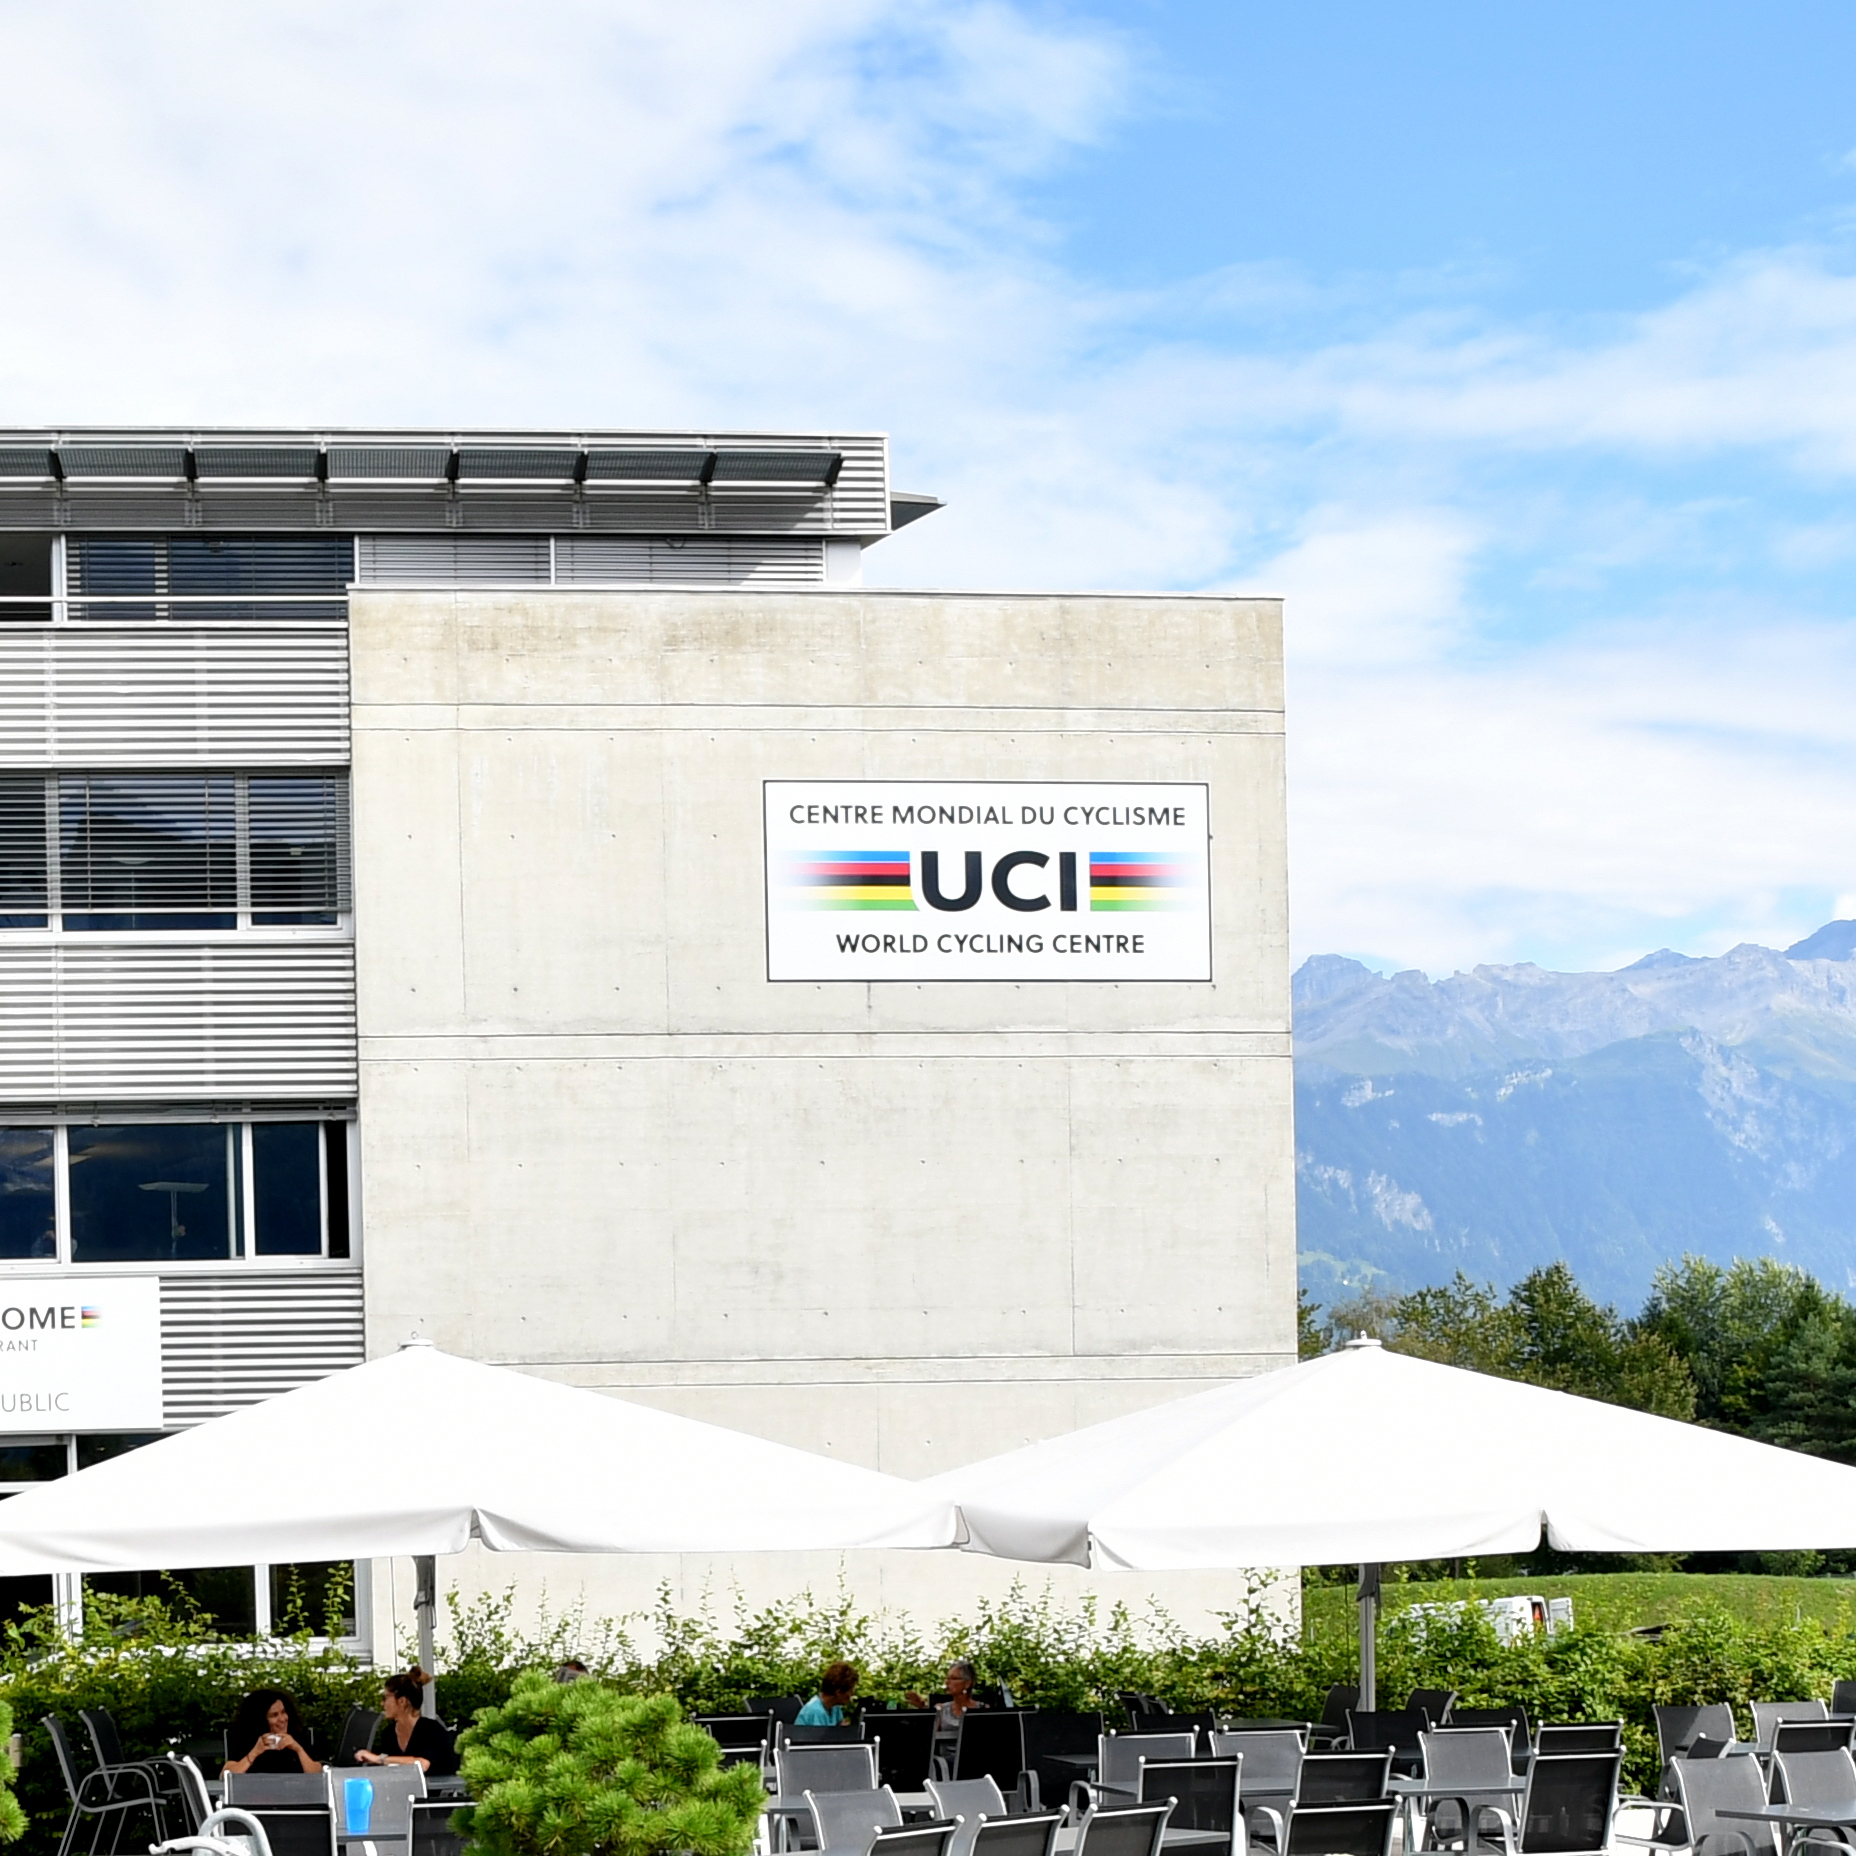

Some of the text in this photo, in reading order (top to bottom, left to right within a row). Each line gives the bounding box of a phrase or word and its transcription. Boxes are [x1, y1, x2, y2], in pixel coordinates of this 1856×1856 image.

[790, 805, 1185, 825] CENTRE MONDIAL DU CYCLISME
[921, 851, 1077, 912] UCI
[836, 934, 1144, 953] WORLD CYCLING CENTRE
